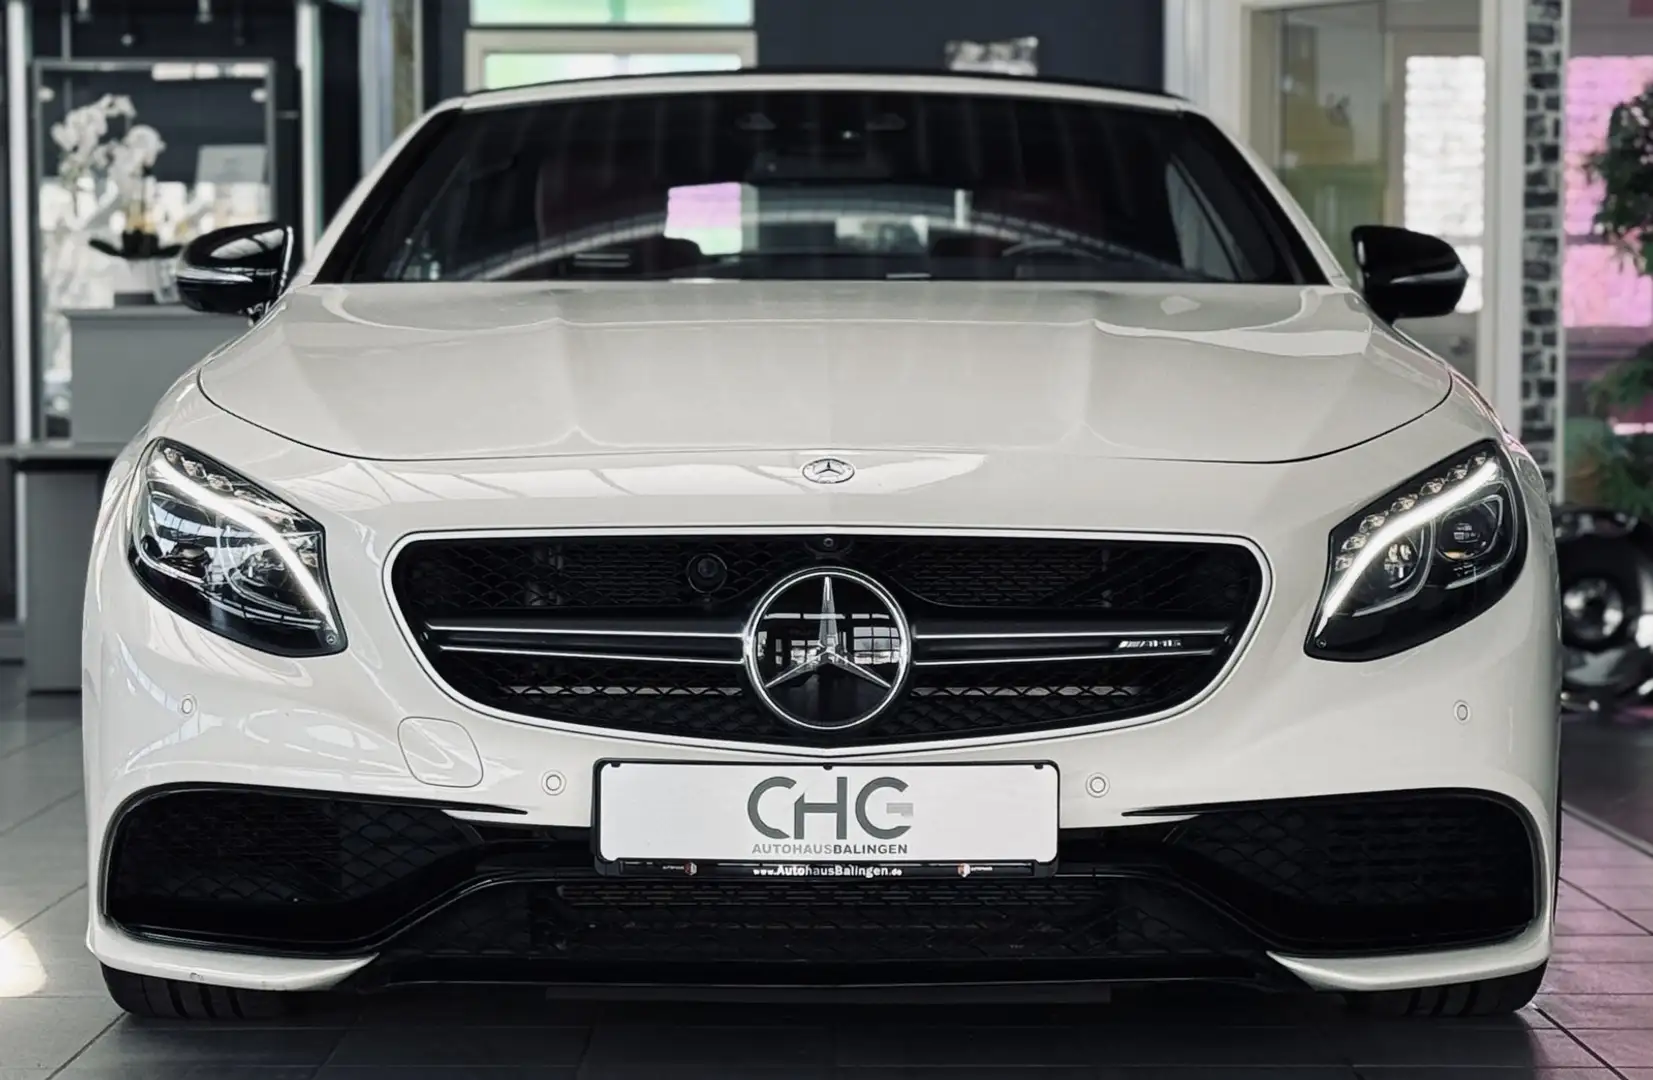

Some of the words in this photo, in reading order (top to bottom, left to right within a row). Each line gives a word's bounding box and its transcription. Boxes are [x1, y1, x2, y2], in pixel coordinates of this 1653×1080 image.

[747, 776, 914, 840] CHG
[751, 843, 908, 855] AUTOHAUSBALINGEN
[752, 864, 903, 878] www.AutohausBalingen.de
